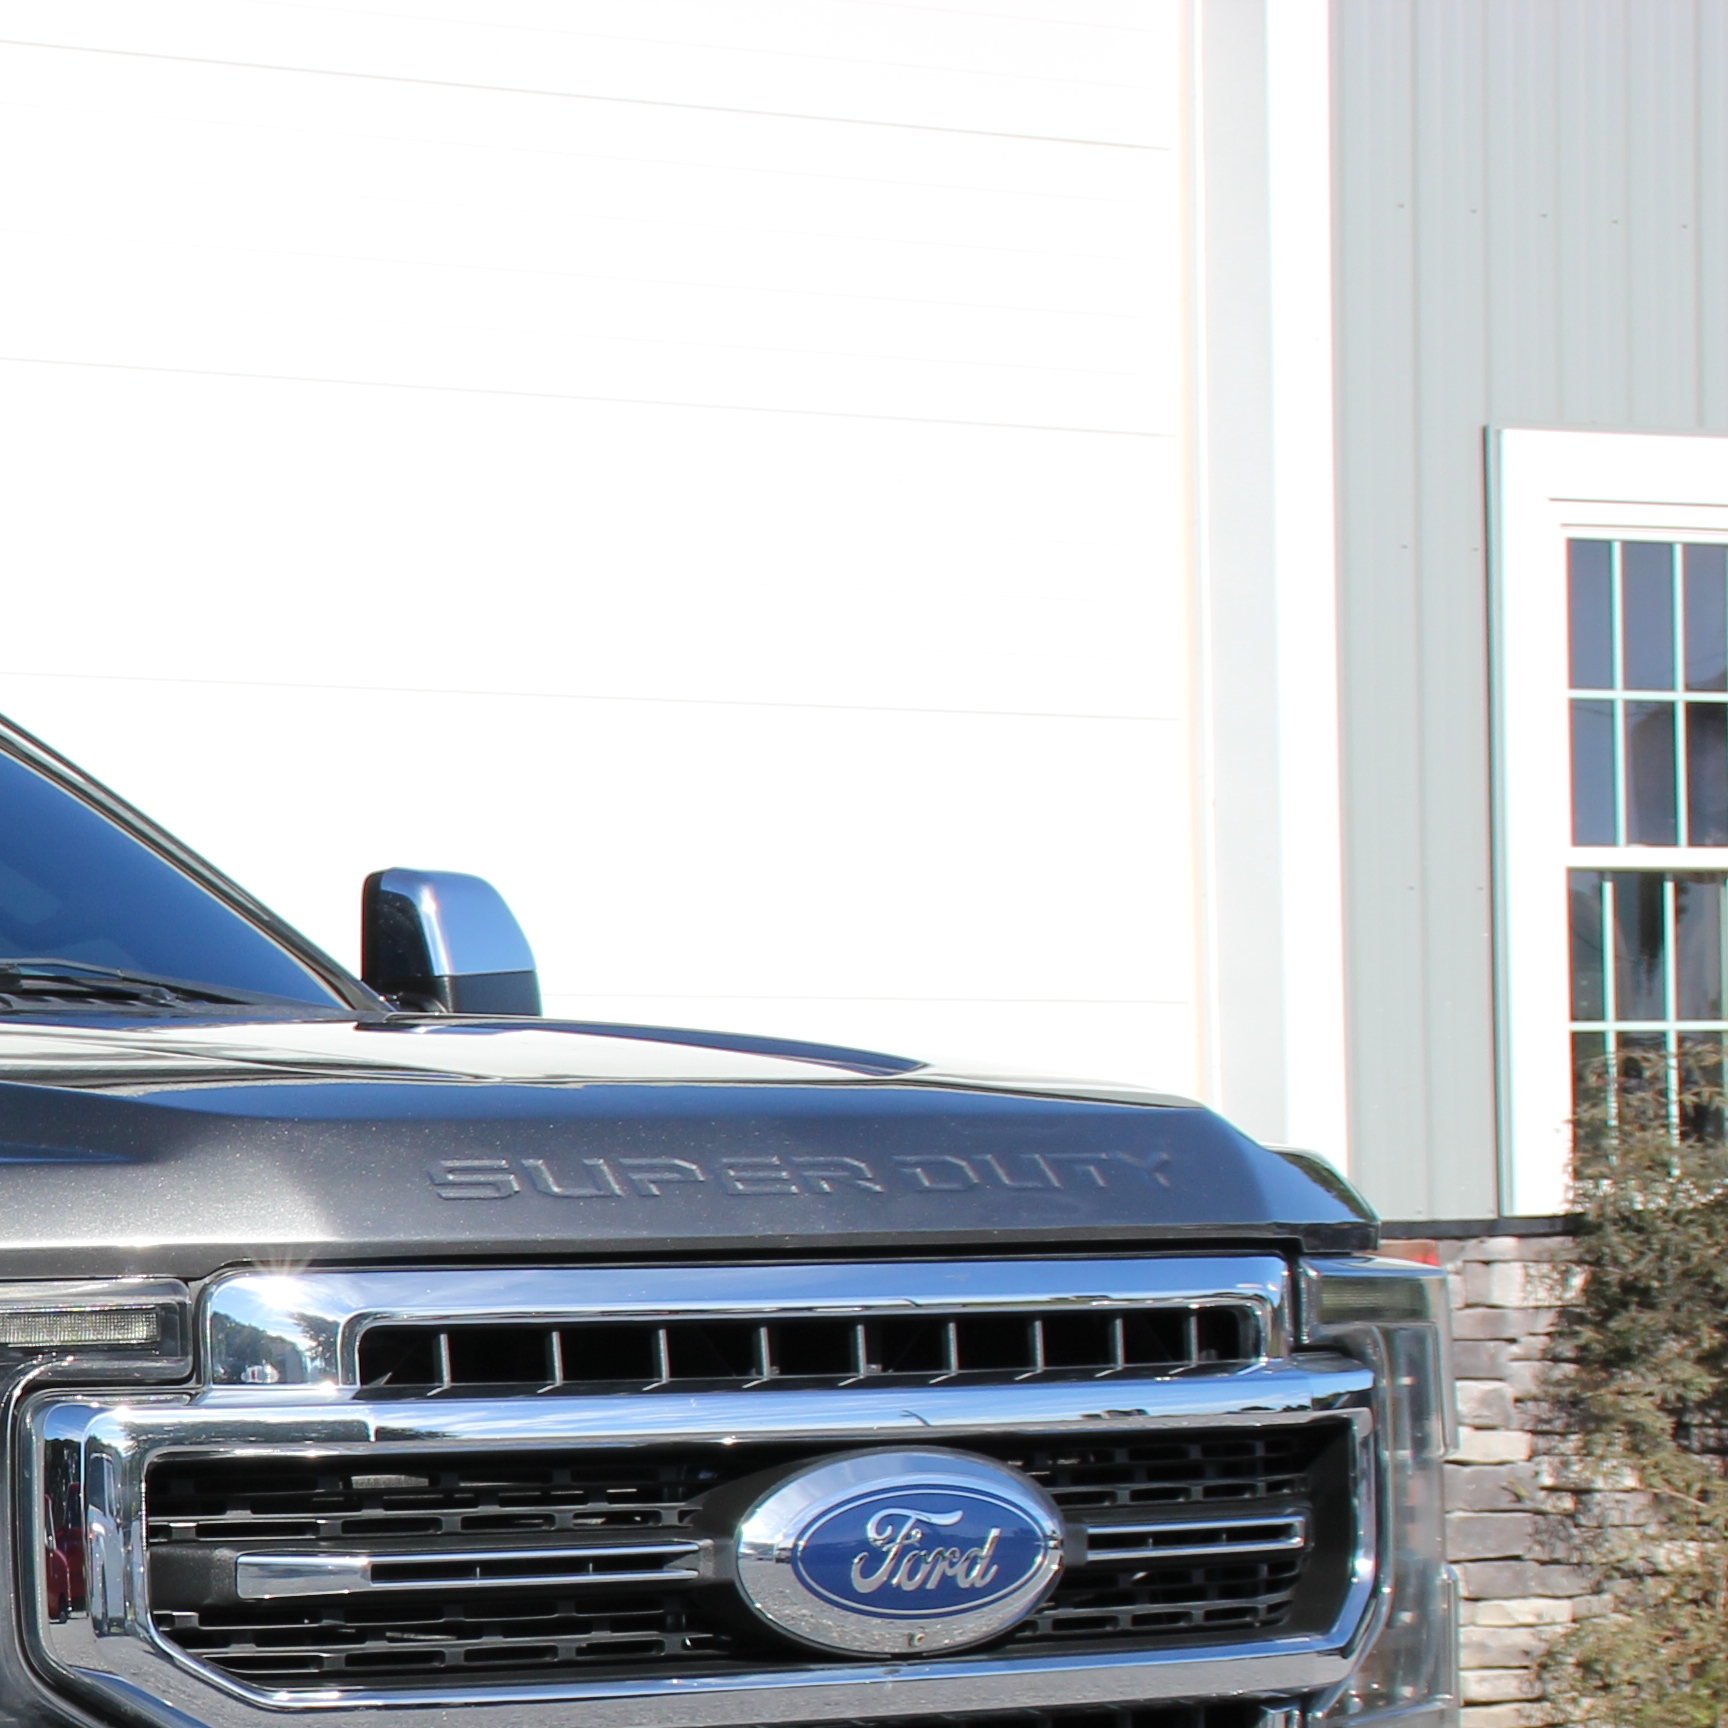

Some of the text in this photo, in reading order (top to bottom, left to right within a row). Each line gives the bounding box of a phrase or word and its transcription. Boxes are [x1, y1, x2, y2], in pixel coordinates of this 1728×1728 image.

[428, 1153, 1172, 1200] SUPER DUTY
[851, 1507, 1001, 1594] Ford
